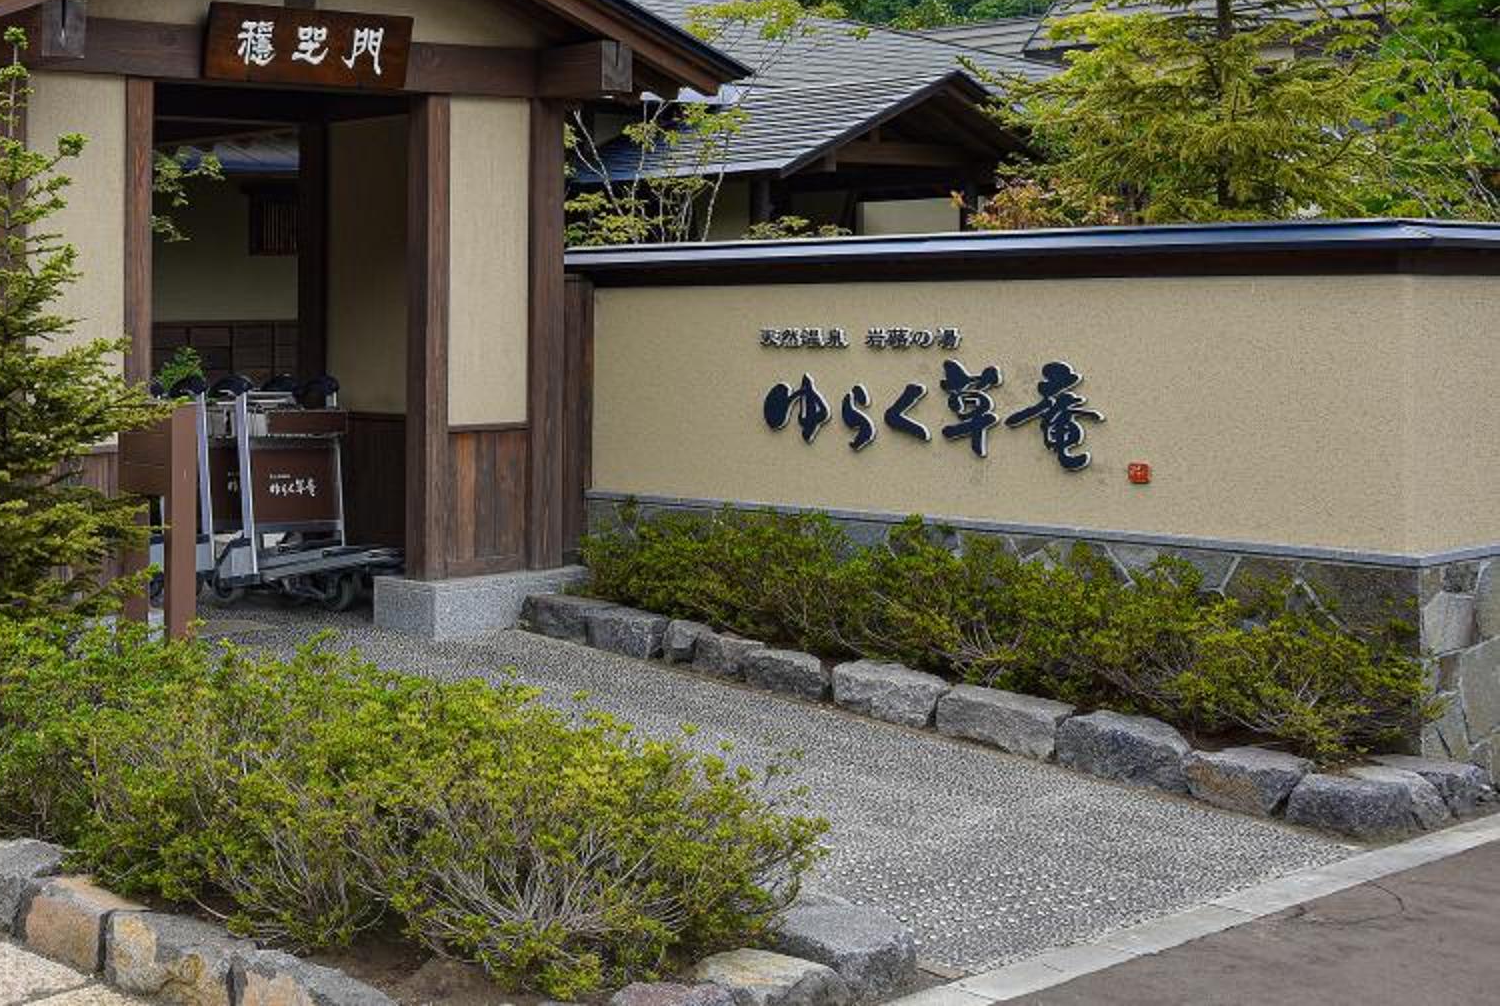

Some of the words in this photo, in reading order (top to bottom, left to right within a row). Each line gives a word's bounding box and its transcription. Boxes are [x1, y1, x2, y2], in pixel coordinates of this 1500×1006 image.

[759, 327, 849, 348] 天然温泉
[763, 357, 1106, 473] ゆらく草庵
